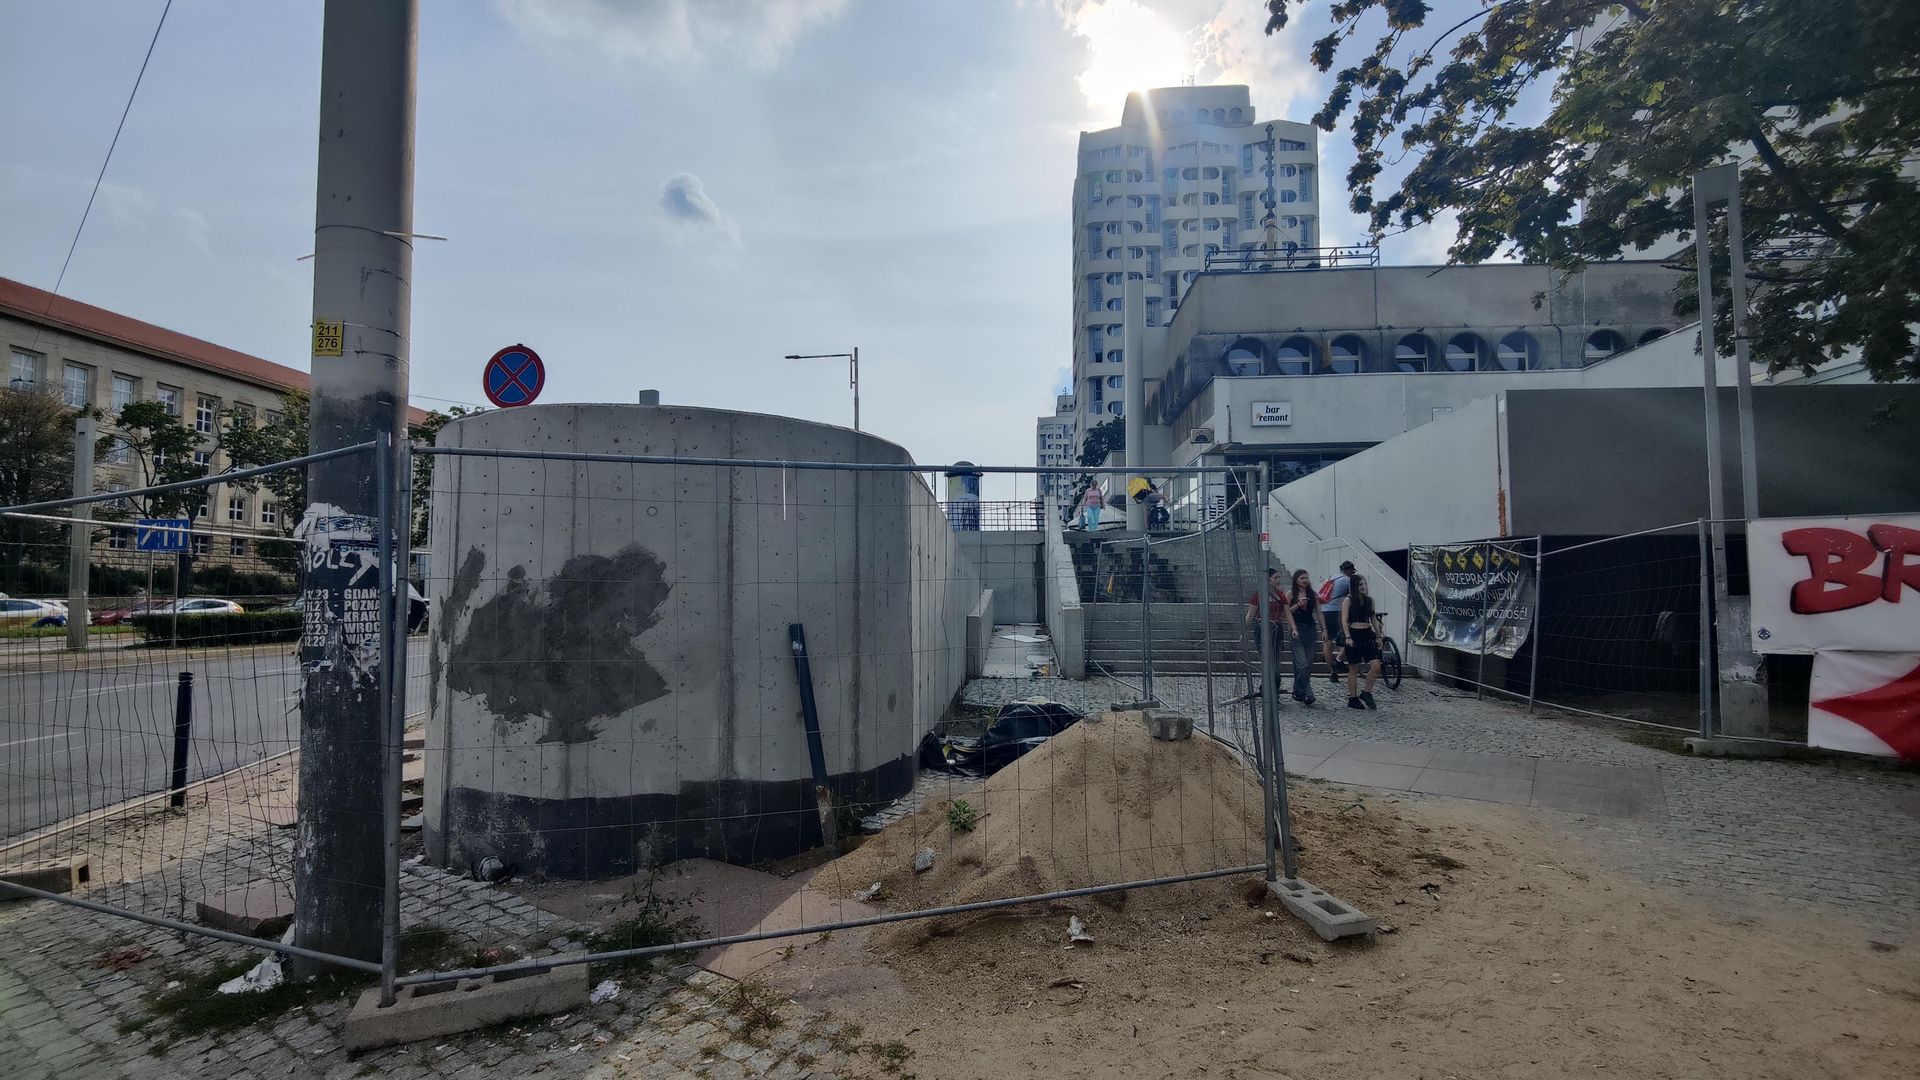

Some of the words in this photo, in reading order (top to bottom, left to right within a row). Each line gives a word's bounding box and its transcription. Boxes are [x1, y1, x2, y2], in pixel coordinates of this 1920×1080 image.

[318, 325, 338, 336] 211
[318, 337, 338, 348] 276
[1265, 405, 1280, 414] bar
[1258, 414, 1288, 422] remont
[1438, 602, 1477, 620] Zachowaj
